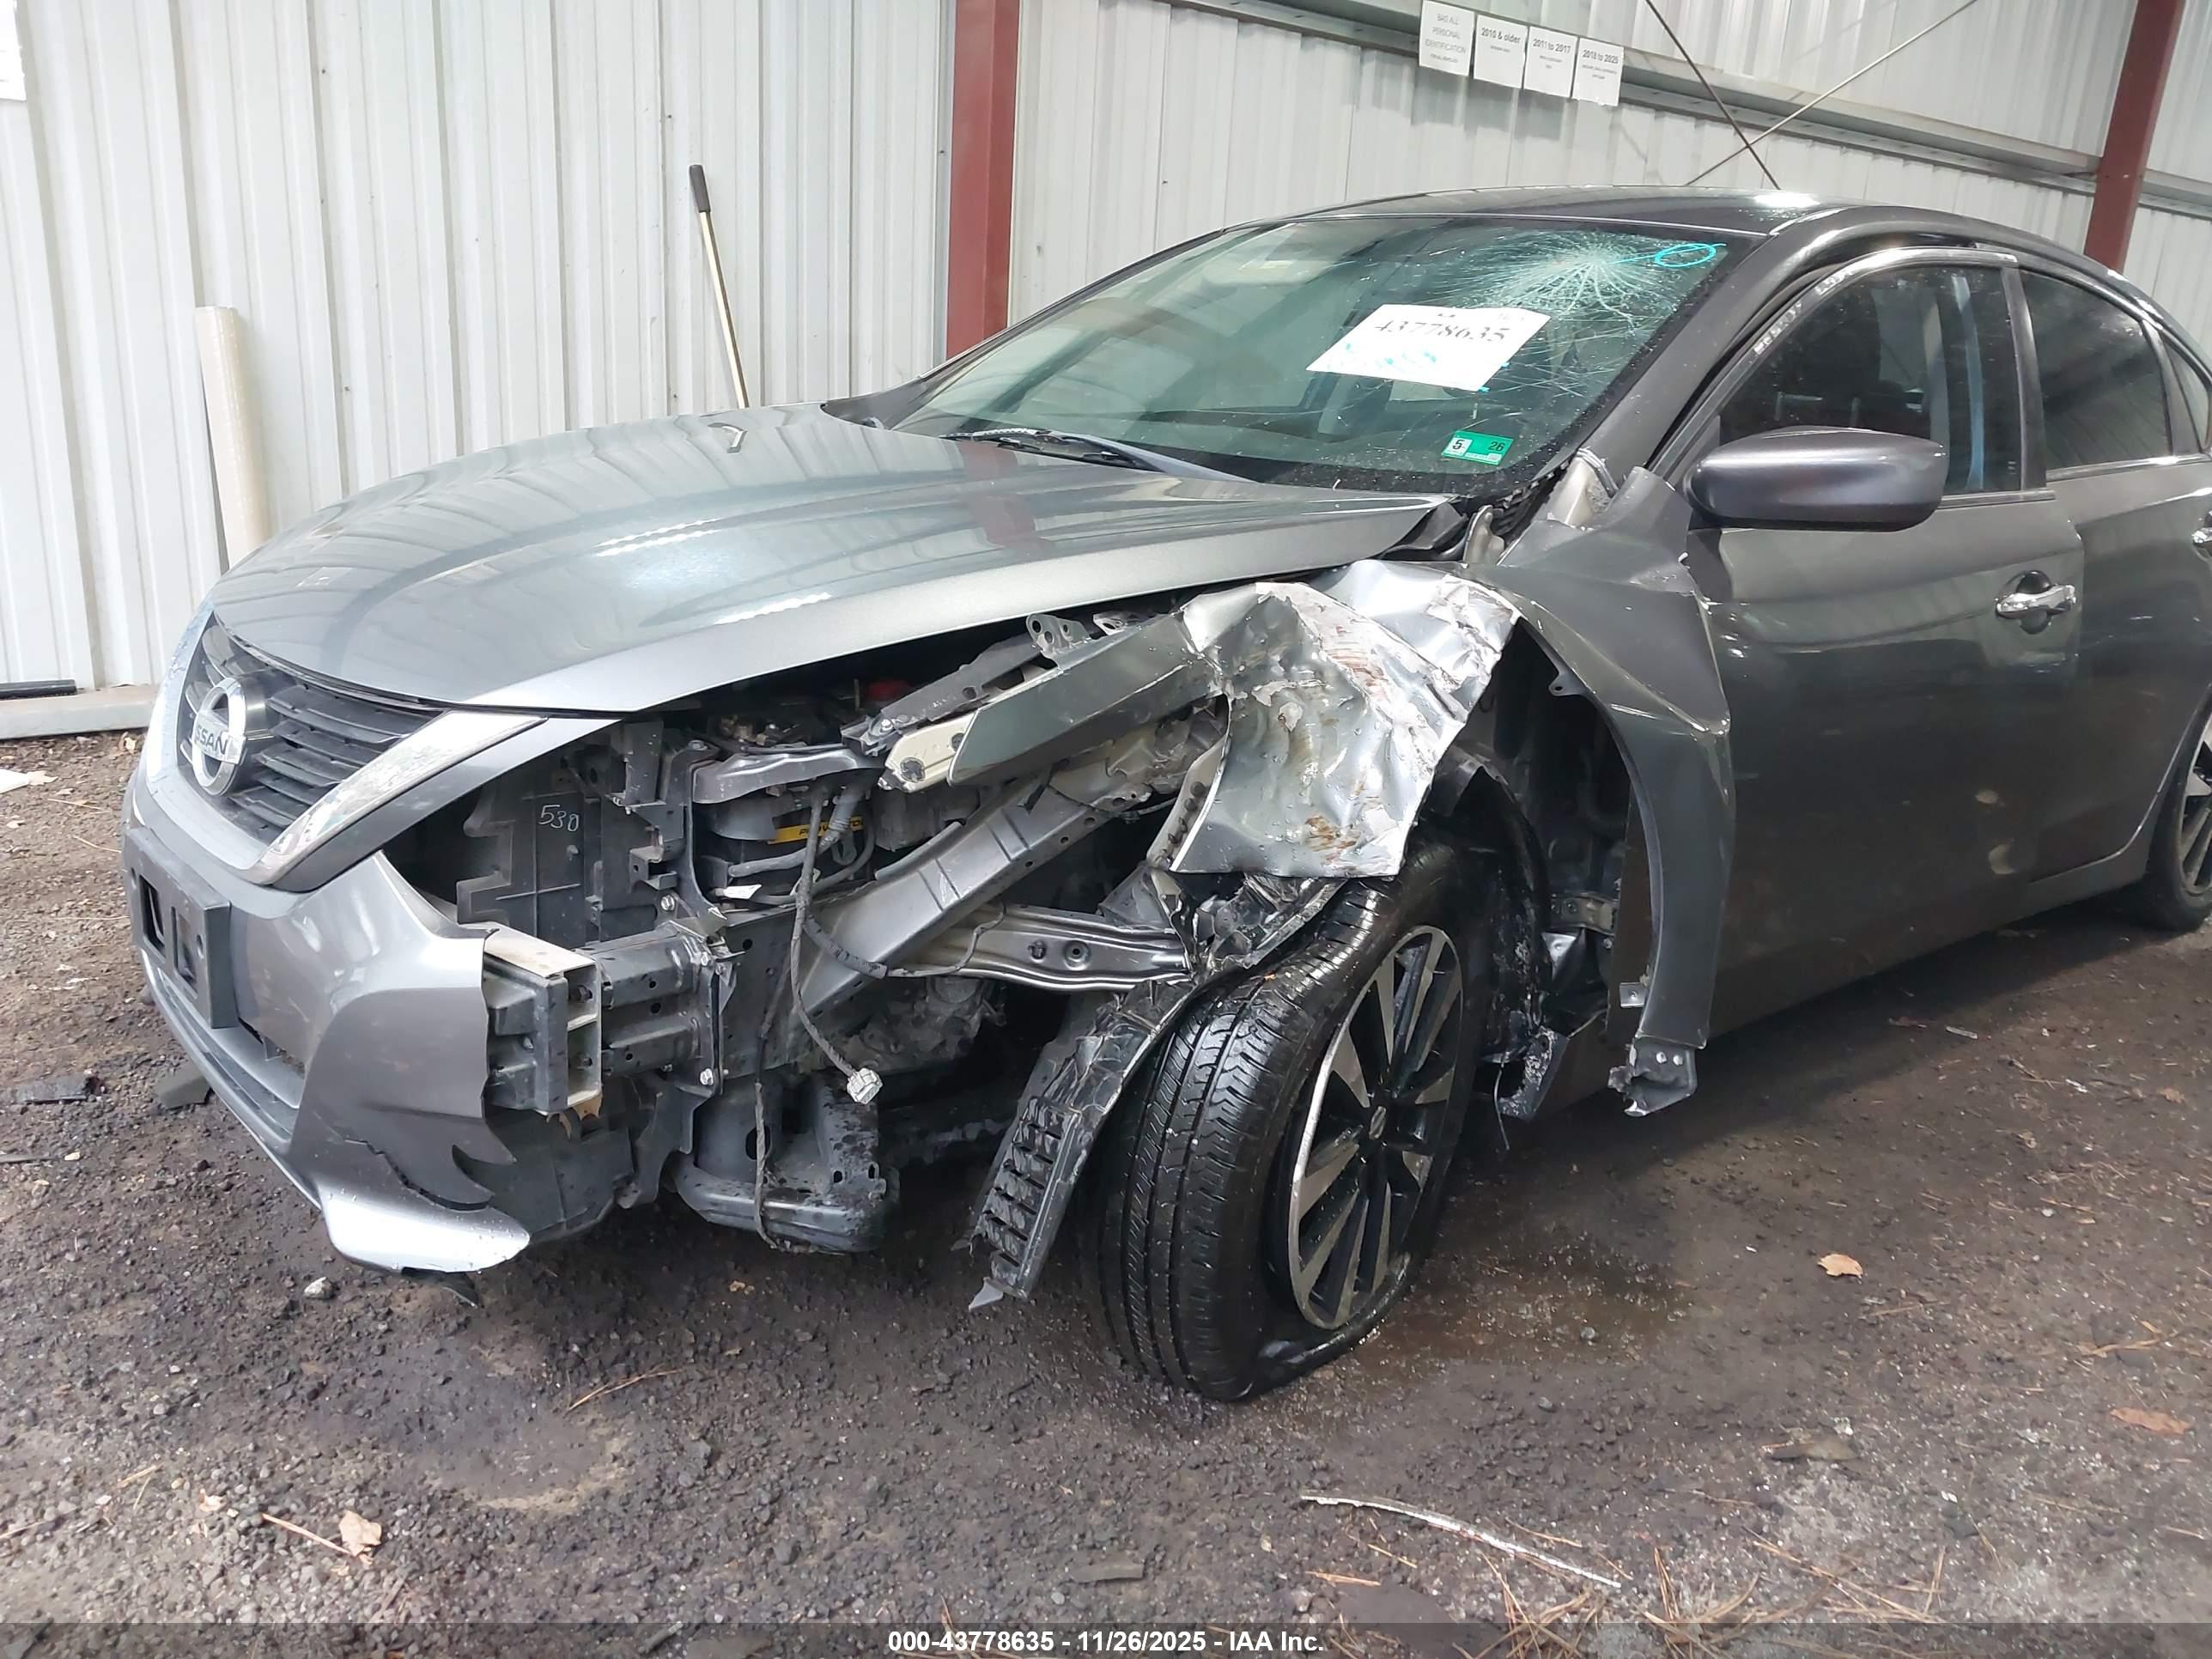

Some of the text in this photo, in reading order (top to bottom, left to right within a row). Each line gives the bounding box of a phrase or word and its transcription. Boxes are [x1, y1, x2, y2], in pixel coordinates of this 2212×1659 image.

[1481, 27, 1521, 44] 2010 & older
[1533, 38, 1571, 53] 2011 to 2017
[1597, 52, 1603, 61] to
[1375, 320, 1510, 342] 43778635
[1453, 439, 1466, 450] 5
[1487, 441, 1505, 452] 26
[538, 804, 580, 832] 530
